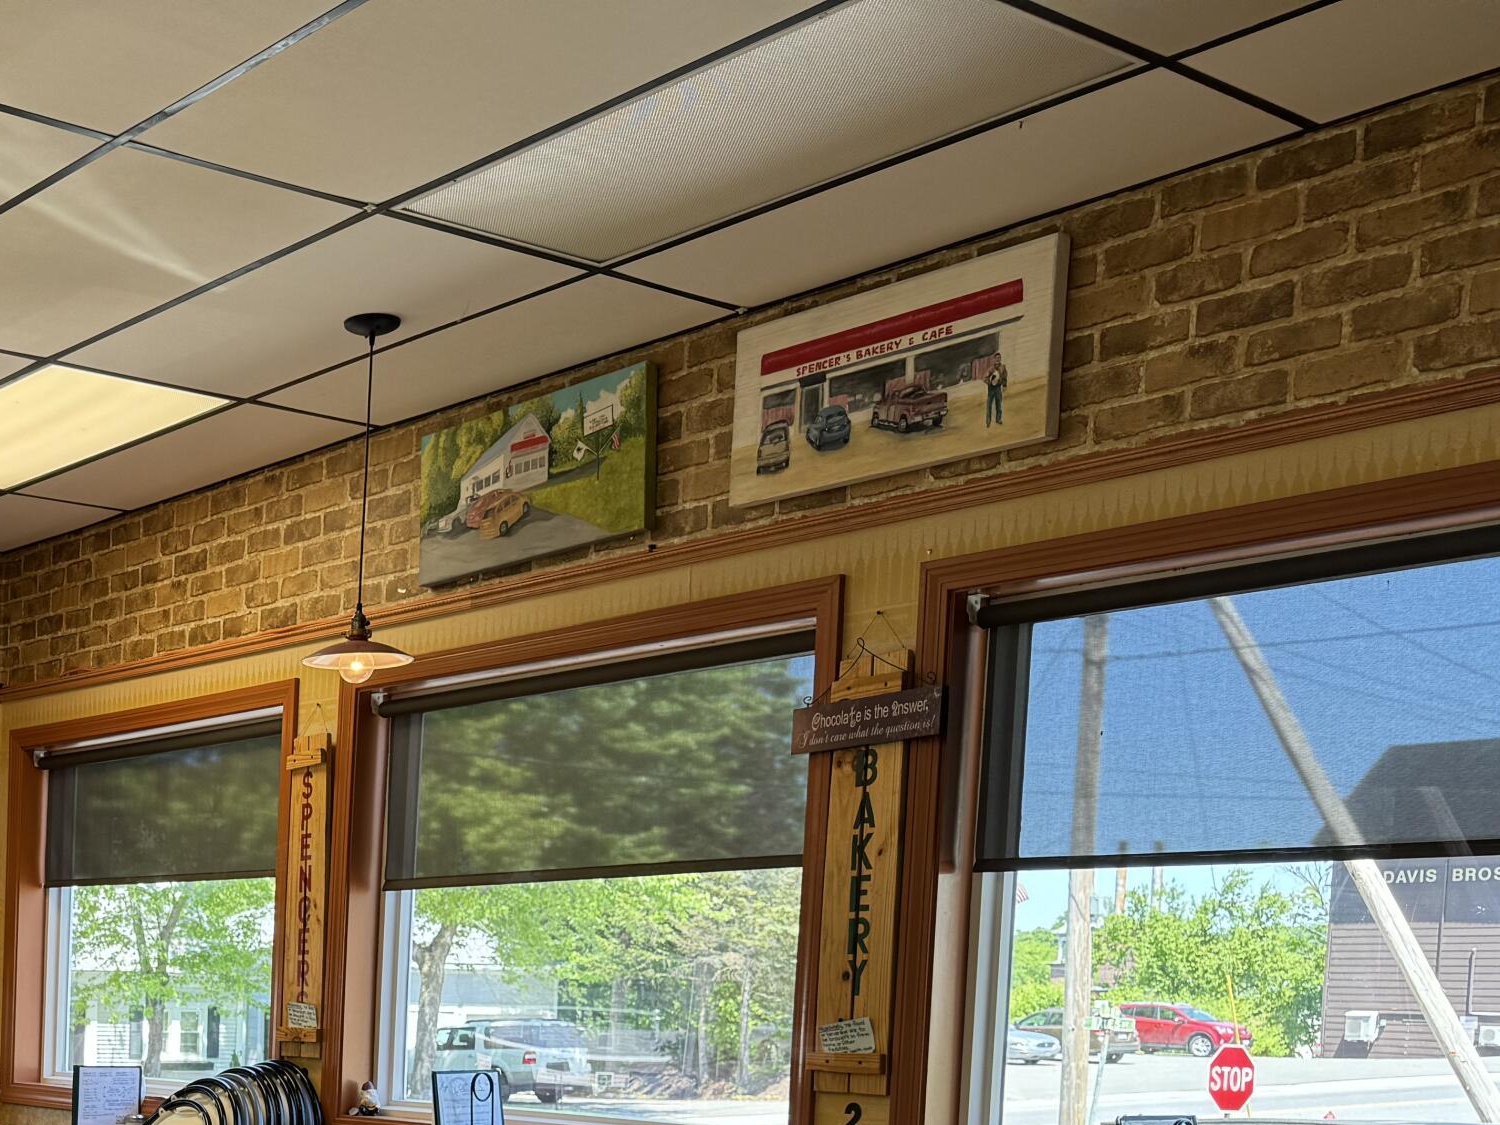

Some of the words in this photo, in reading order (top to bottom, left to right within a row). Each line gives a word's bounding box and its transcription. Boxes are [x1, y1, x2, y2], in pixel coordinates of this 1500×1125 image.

[796, 352, 851, 377] SPENCER'S
[856, 339, 902, 360] BAKERY
[922, 325, 953, 341] CAFE
[809, 731, 829, 746] don't
[830, 732, 846, 743] care
[849, 726, 869, 739] what
[870, 723, 884, 736] the
[885, 719, 920, 735] question
[922, 714, 936, 728] is!
[811, 705, 861, 731] Chocolate
[863, 706, 872, 721] is
[874, 704, 888, 718] the
[847, 748, 878, 996] BAKERY
[1383, 868, 1438, 884] DAVIS
[1210, 1065, 1253, 1092] STOP
